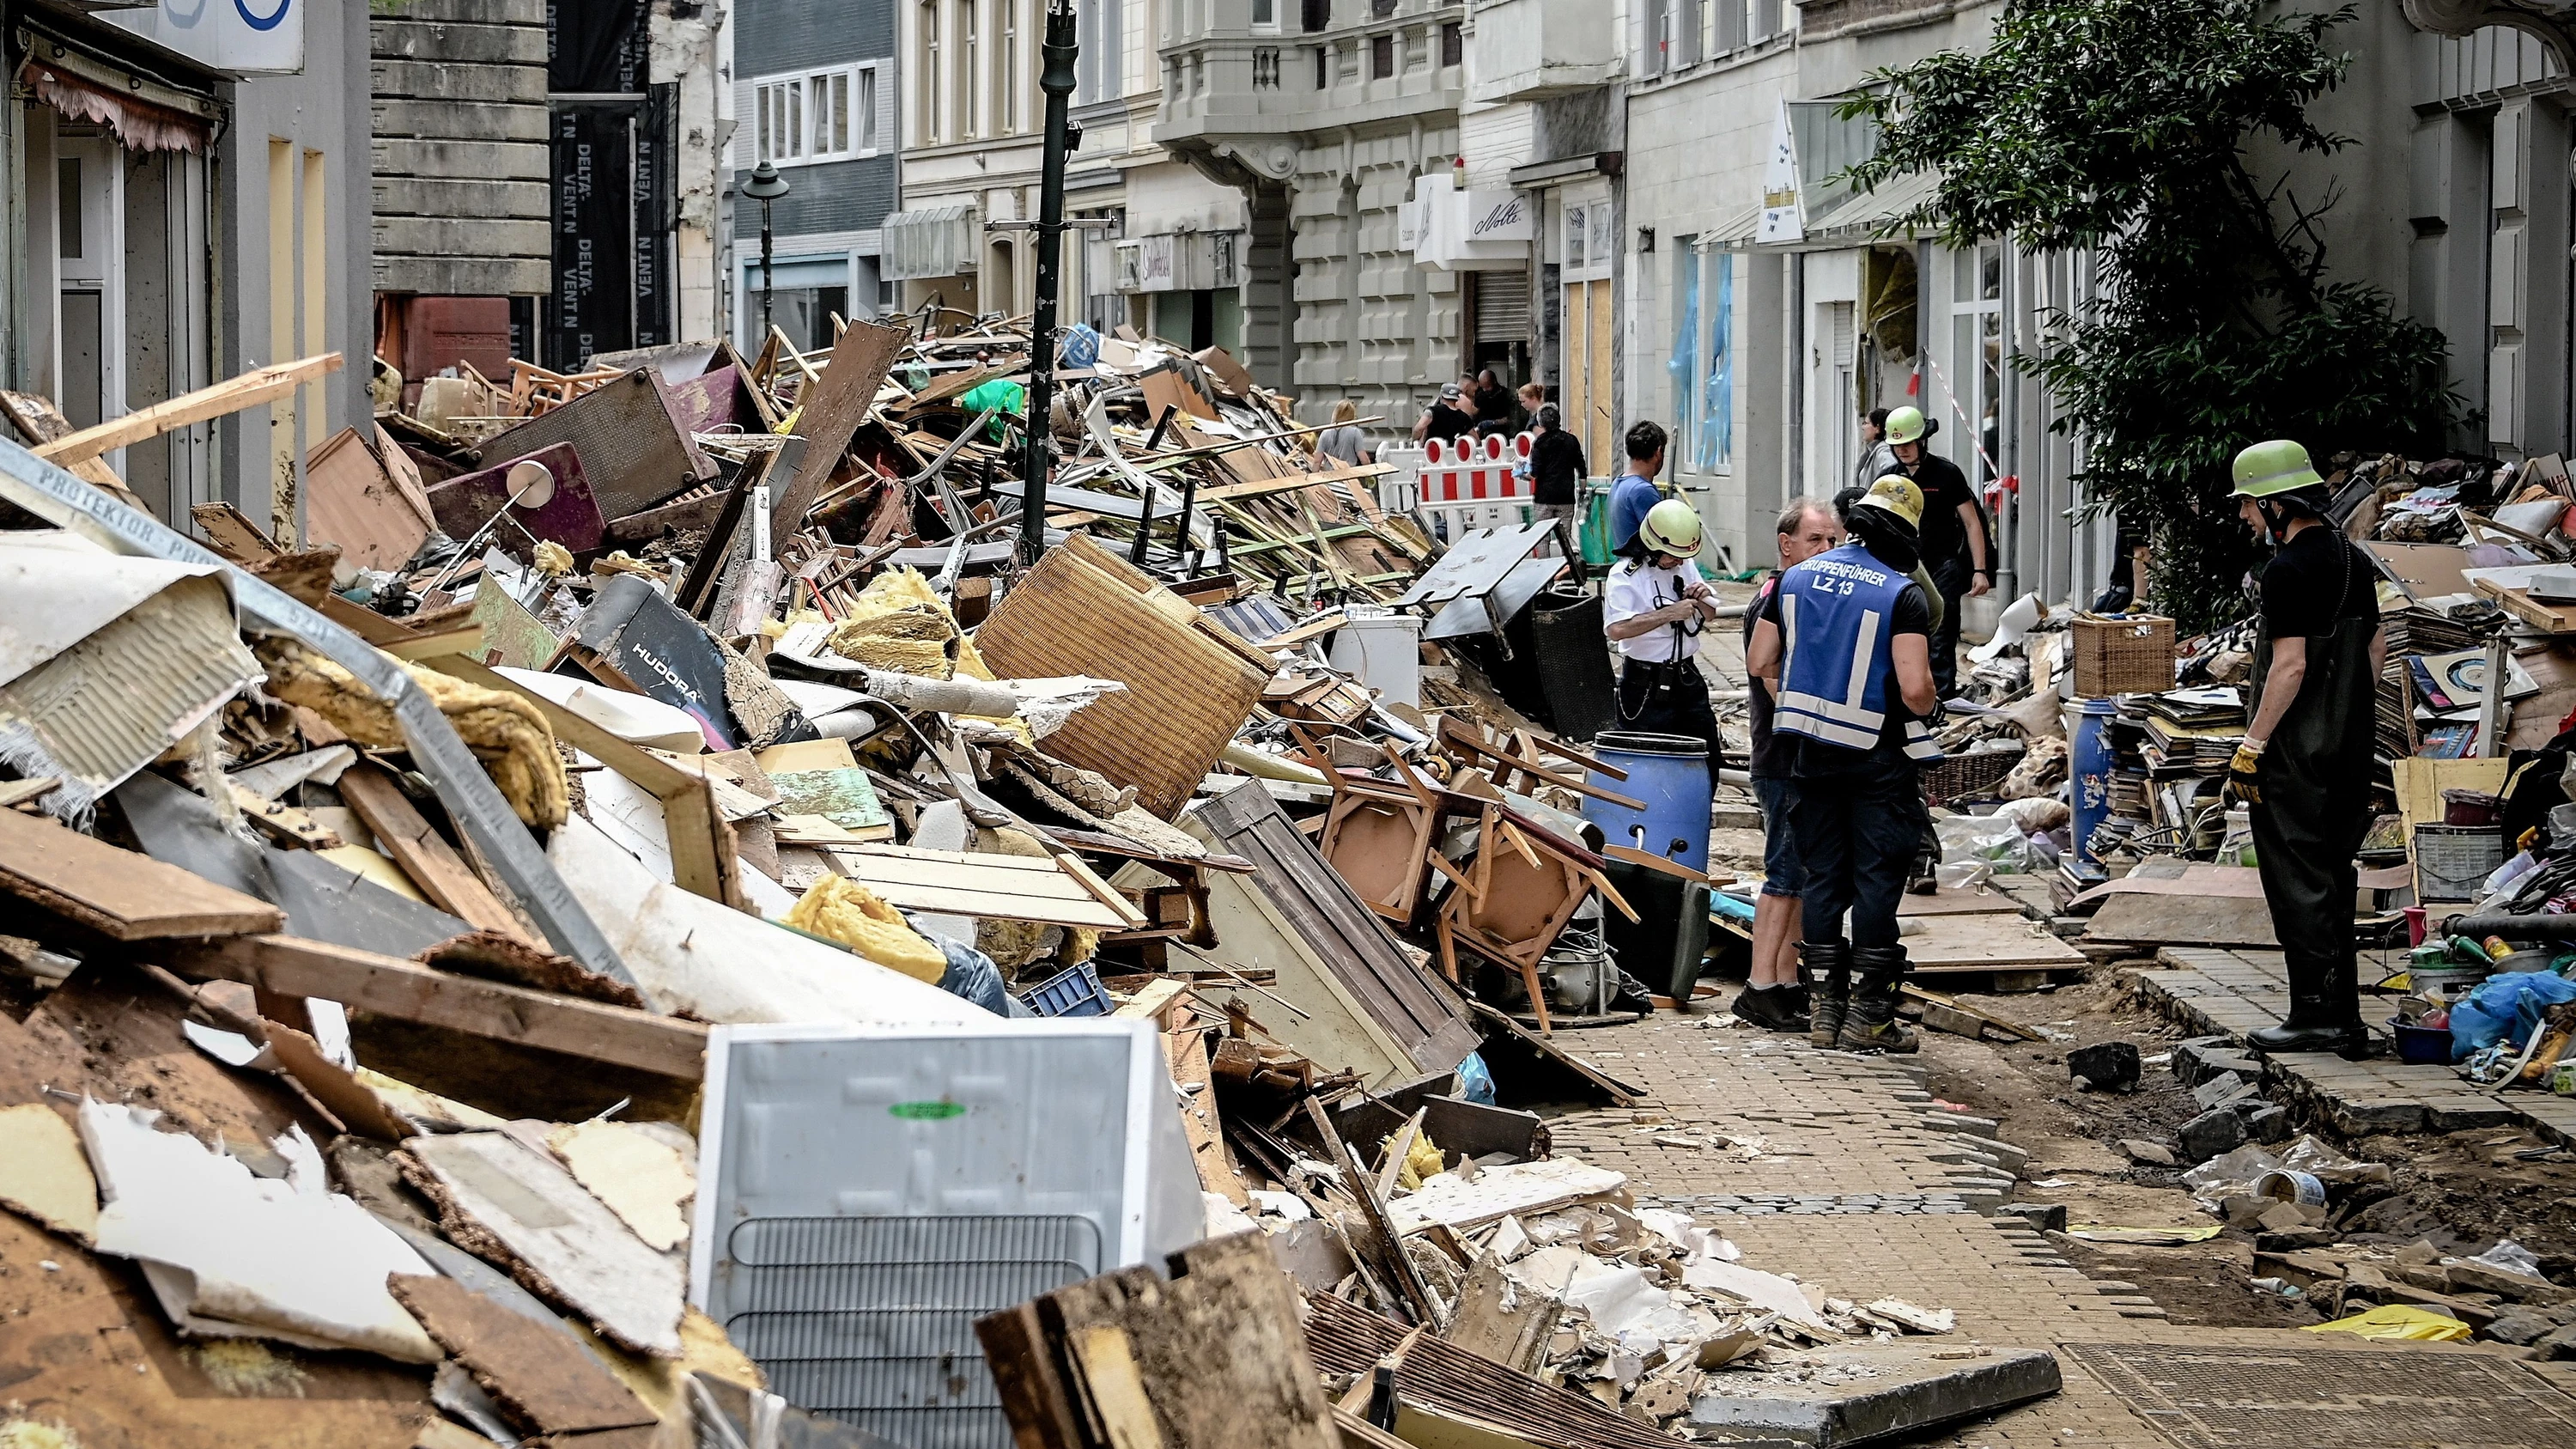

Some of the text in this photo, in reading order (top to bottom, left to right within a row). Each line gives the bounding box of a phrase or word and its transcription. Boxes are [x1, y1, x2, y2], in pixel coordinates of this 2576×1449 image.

[563, 174, 577, 234] VENT N
[638, 237, 653, 298] VENT N
[563, 268, 578, 328] VENT N
[39, 470, 156, 542] PROTEKTOR
[1800, 559, 1887, 588] GRUPPENFÜHRER
[1811, 575, 1855, 595] LZ 13
[632, 642, 698, 703] HUDORA
